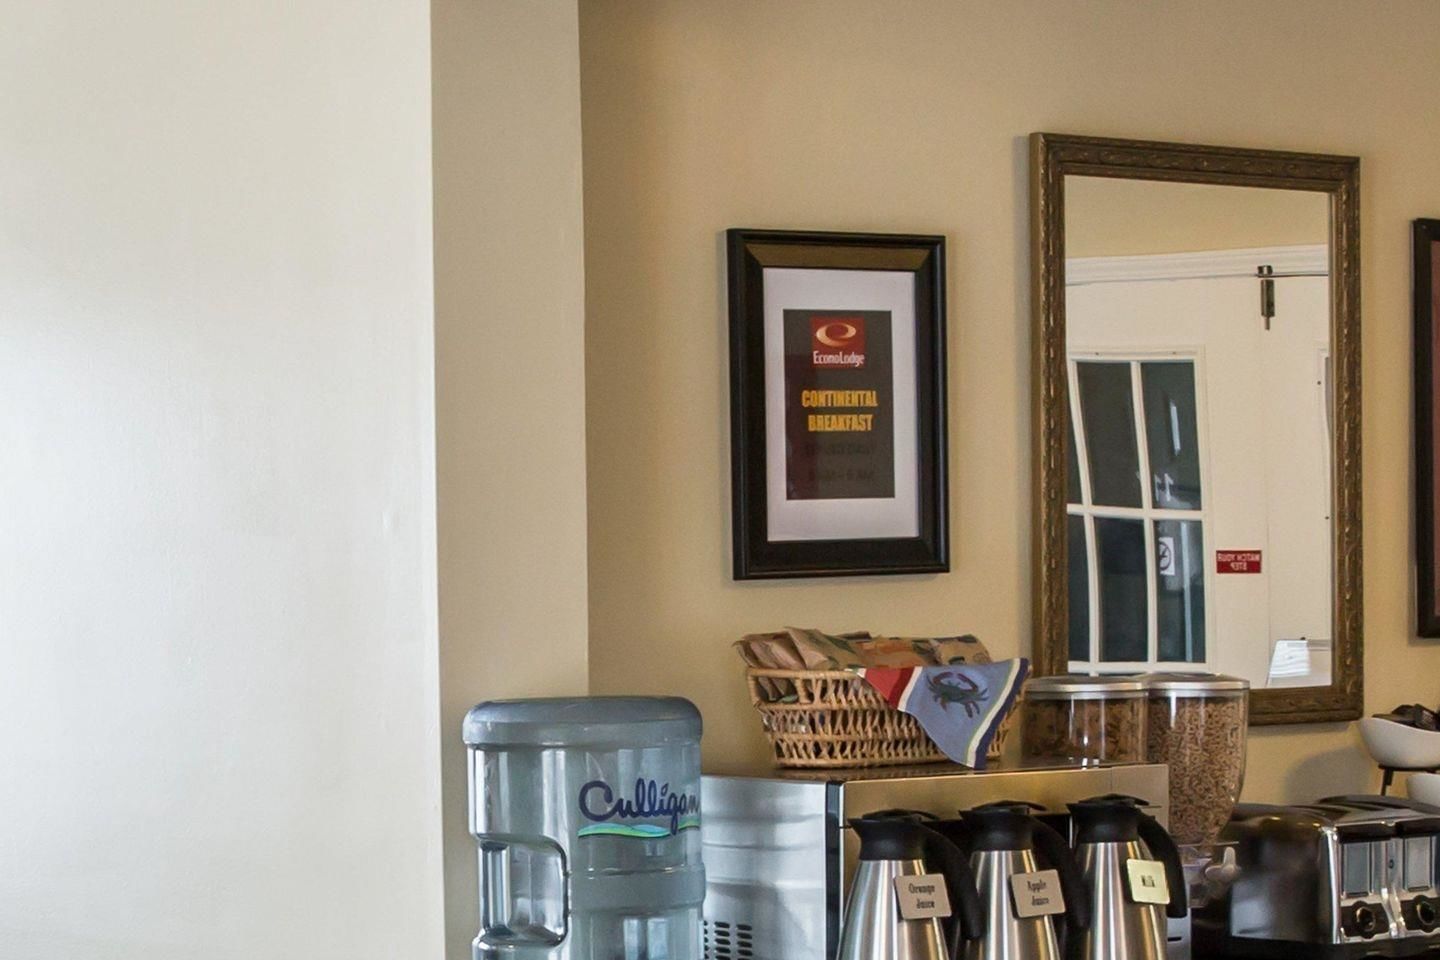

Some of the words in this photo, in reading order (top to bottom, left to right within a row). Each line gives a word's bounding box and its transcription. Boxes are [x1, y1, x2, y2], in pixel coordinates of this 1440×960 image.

[813, 350, 865, 367] EconoLodge
[801, 390, 879, 407] CONTINENTAL
[807, 414, 873, 431] BREAKFAST
[578, 778, 700, 836] Culligan
[908, 883, 935, 895] Orange
